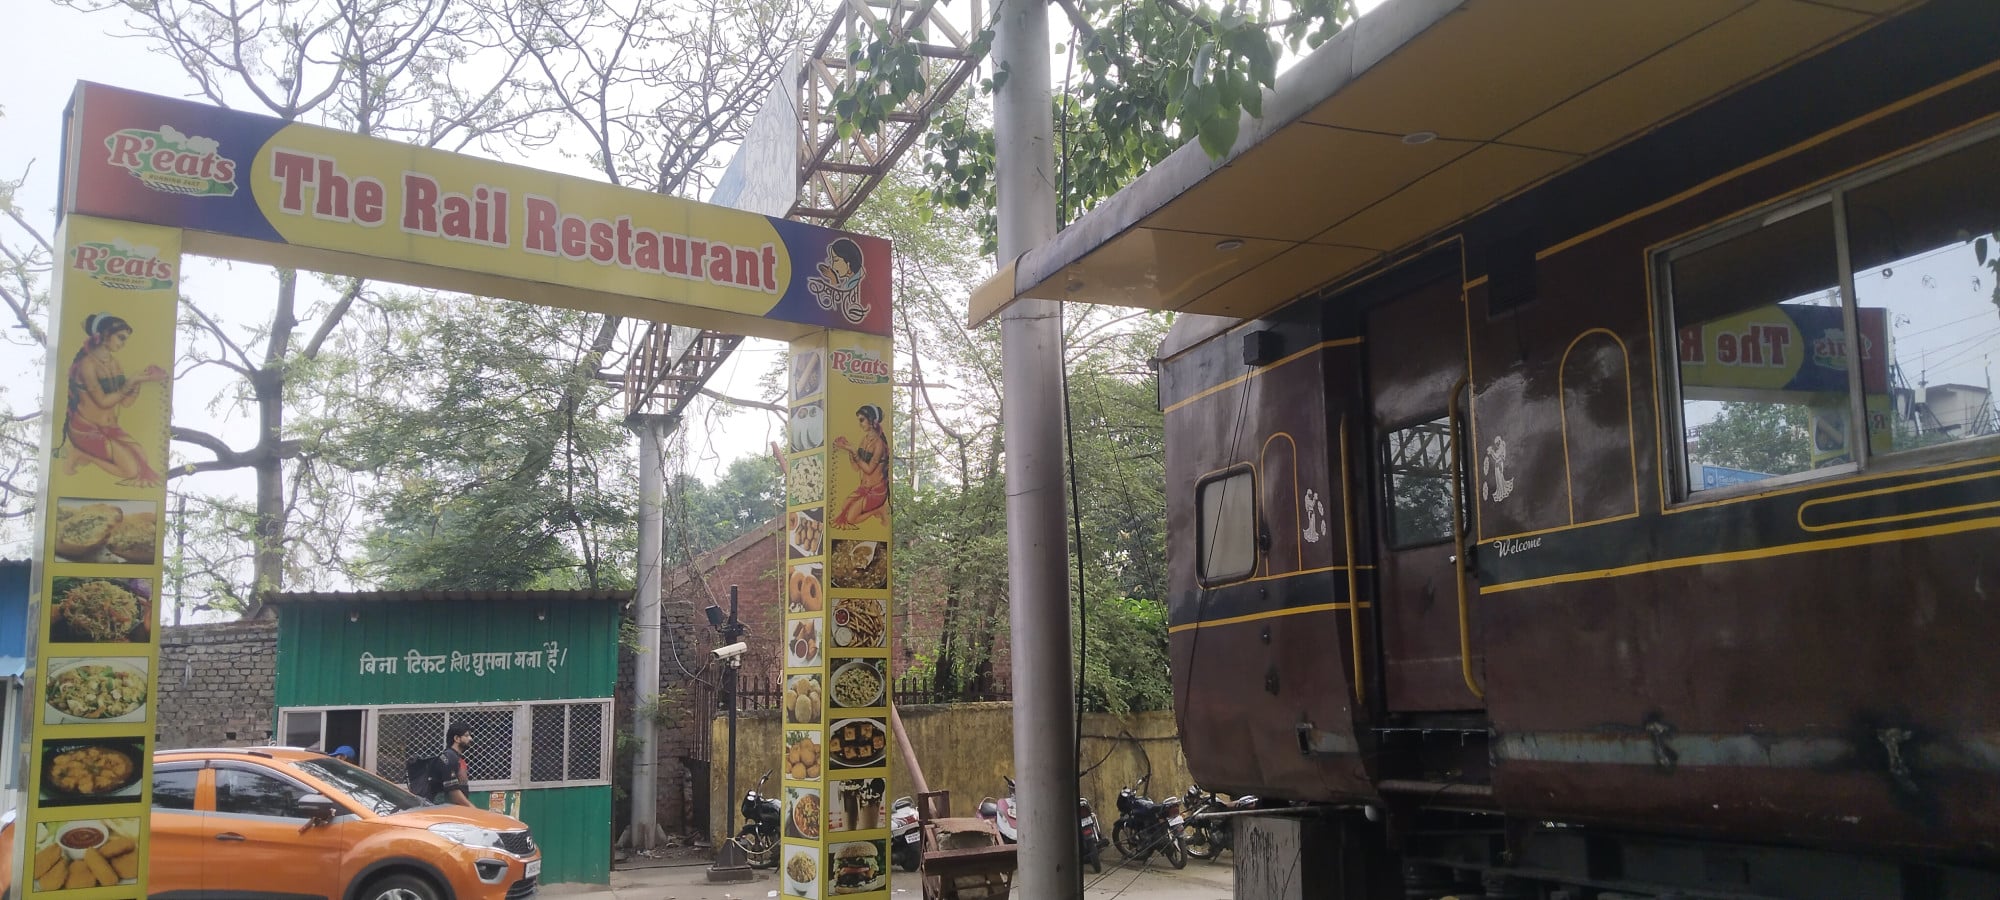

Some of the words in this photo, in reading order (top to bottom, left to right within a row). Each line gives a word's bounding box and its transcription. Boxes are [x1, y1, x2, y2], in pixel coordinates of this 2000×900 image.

[107, 132, 236, 184] R'eats
[272, 149, 385, 224] The
[403, 172, 508, 246] Rail
[524, 196, 778, 291] Restaurant
[72, 243, 172, 281] R'eats
[831, 350, 889, 376] R'eats
[1493, 538, 1541, 558] Welcome
[359, 651, 398, 675] बिना
[404, 648, 447, 675] टिकट
[472, 652, 511, 677] घुसना
[515, 650, 542, 670] मना
